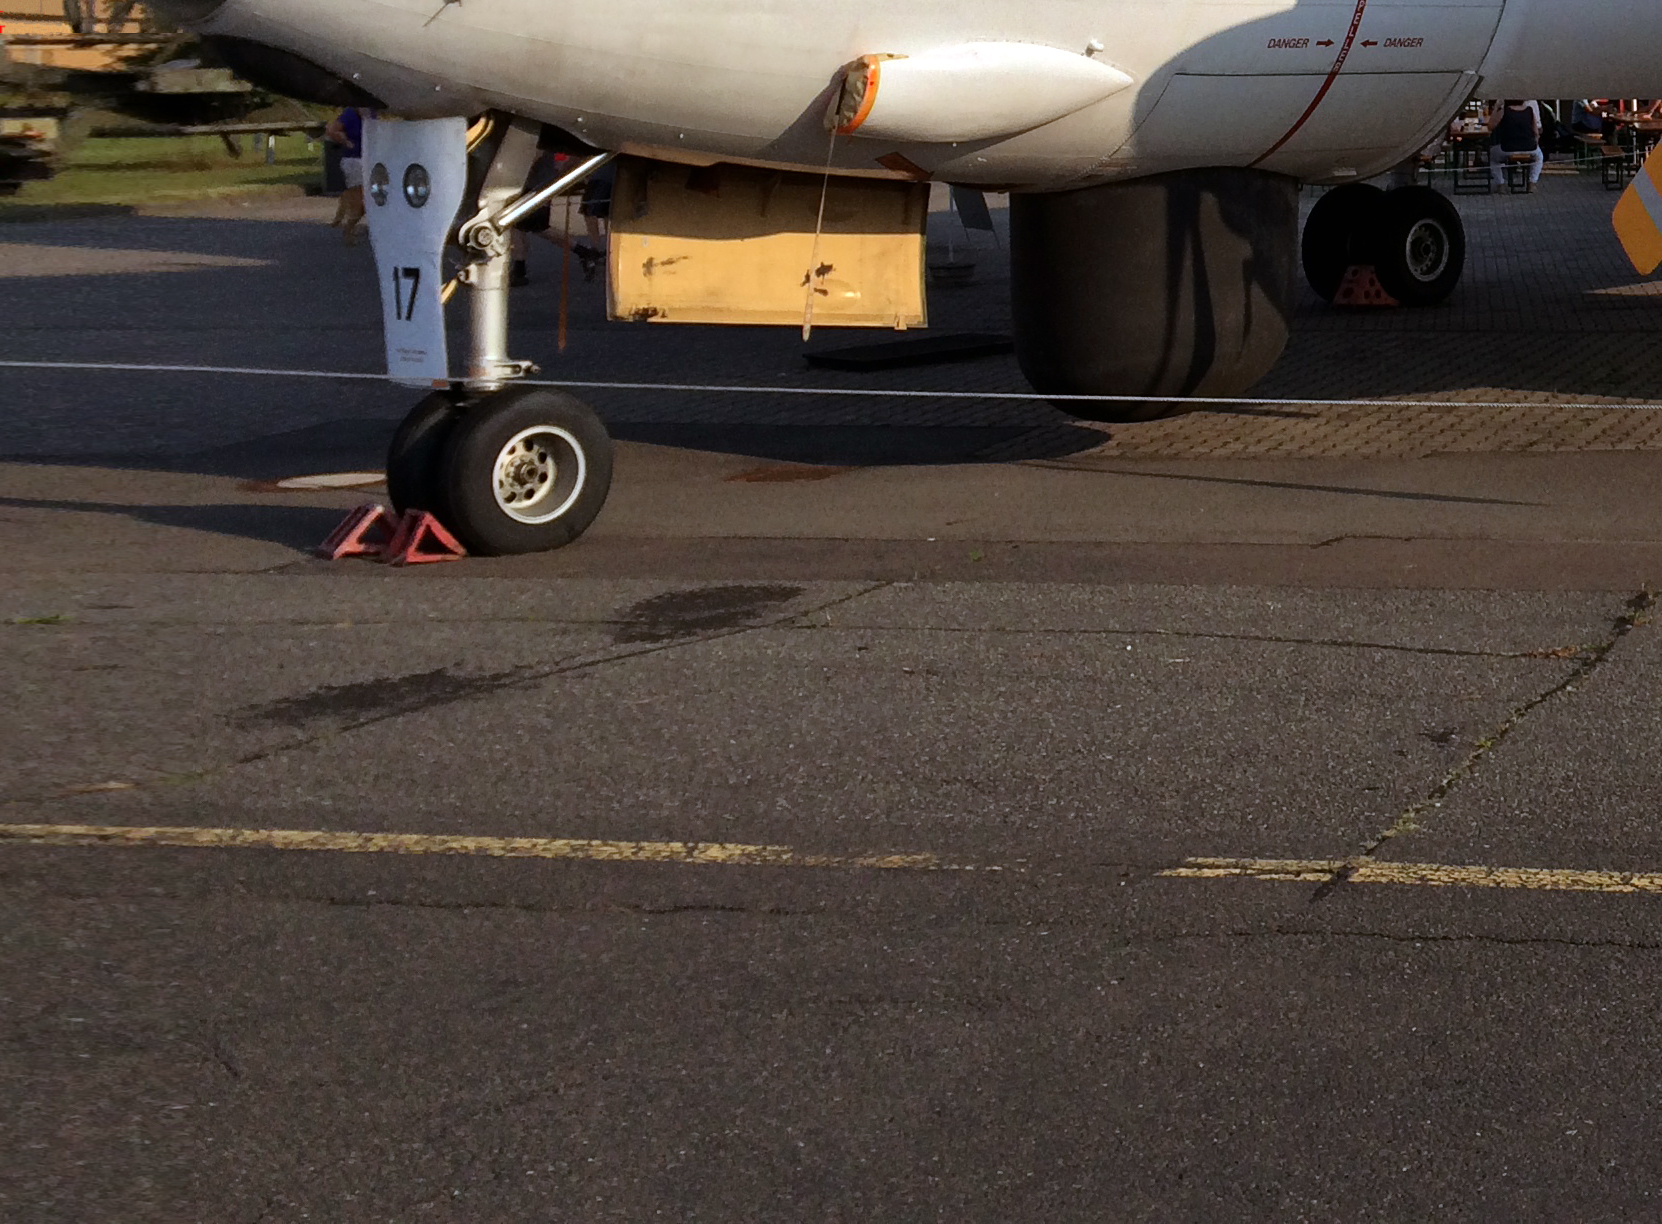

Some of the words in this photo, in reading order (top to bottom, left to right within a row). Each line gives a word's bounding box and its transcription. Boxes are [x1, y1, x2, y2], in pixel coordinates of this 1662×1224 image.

[1267, 38, 1310, 48] DANGER
[1383, 37, 1424, 48] DANGER
[393, 266, 420, 321] 17
